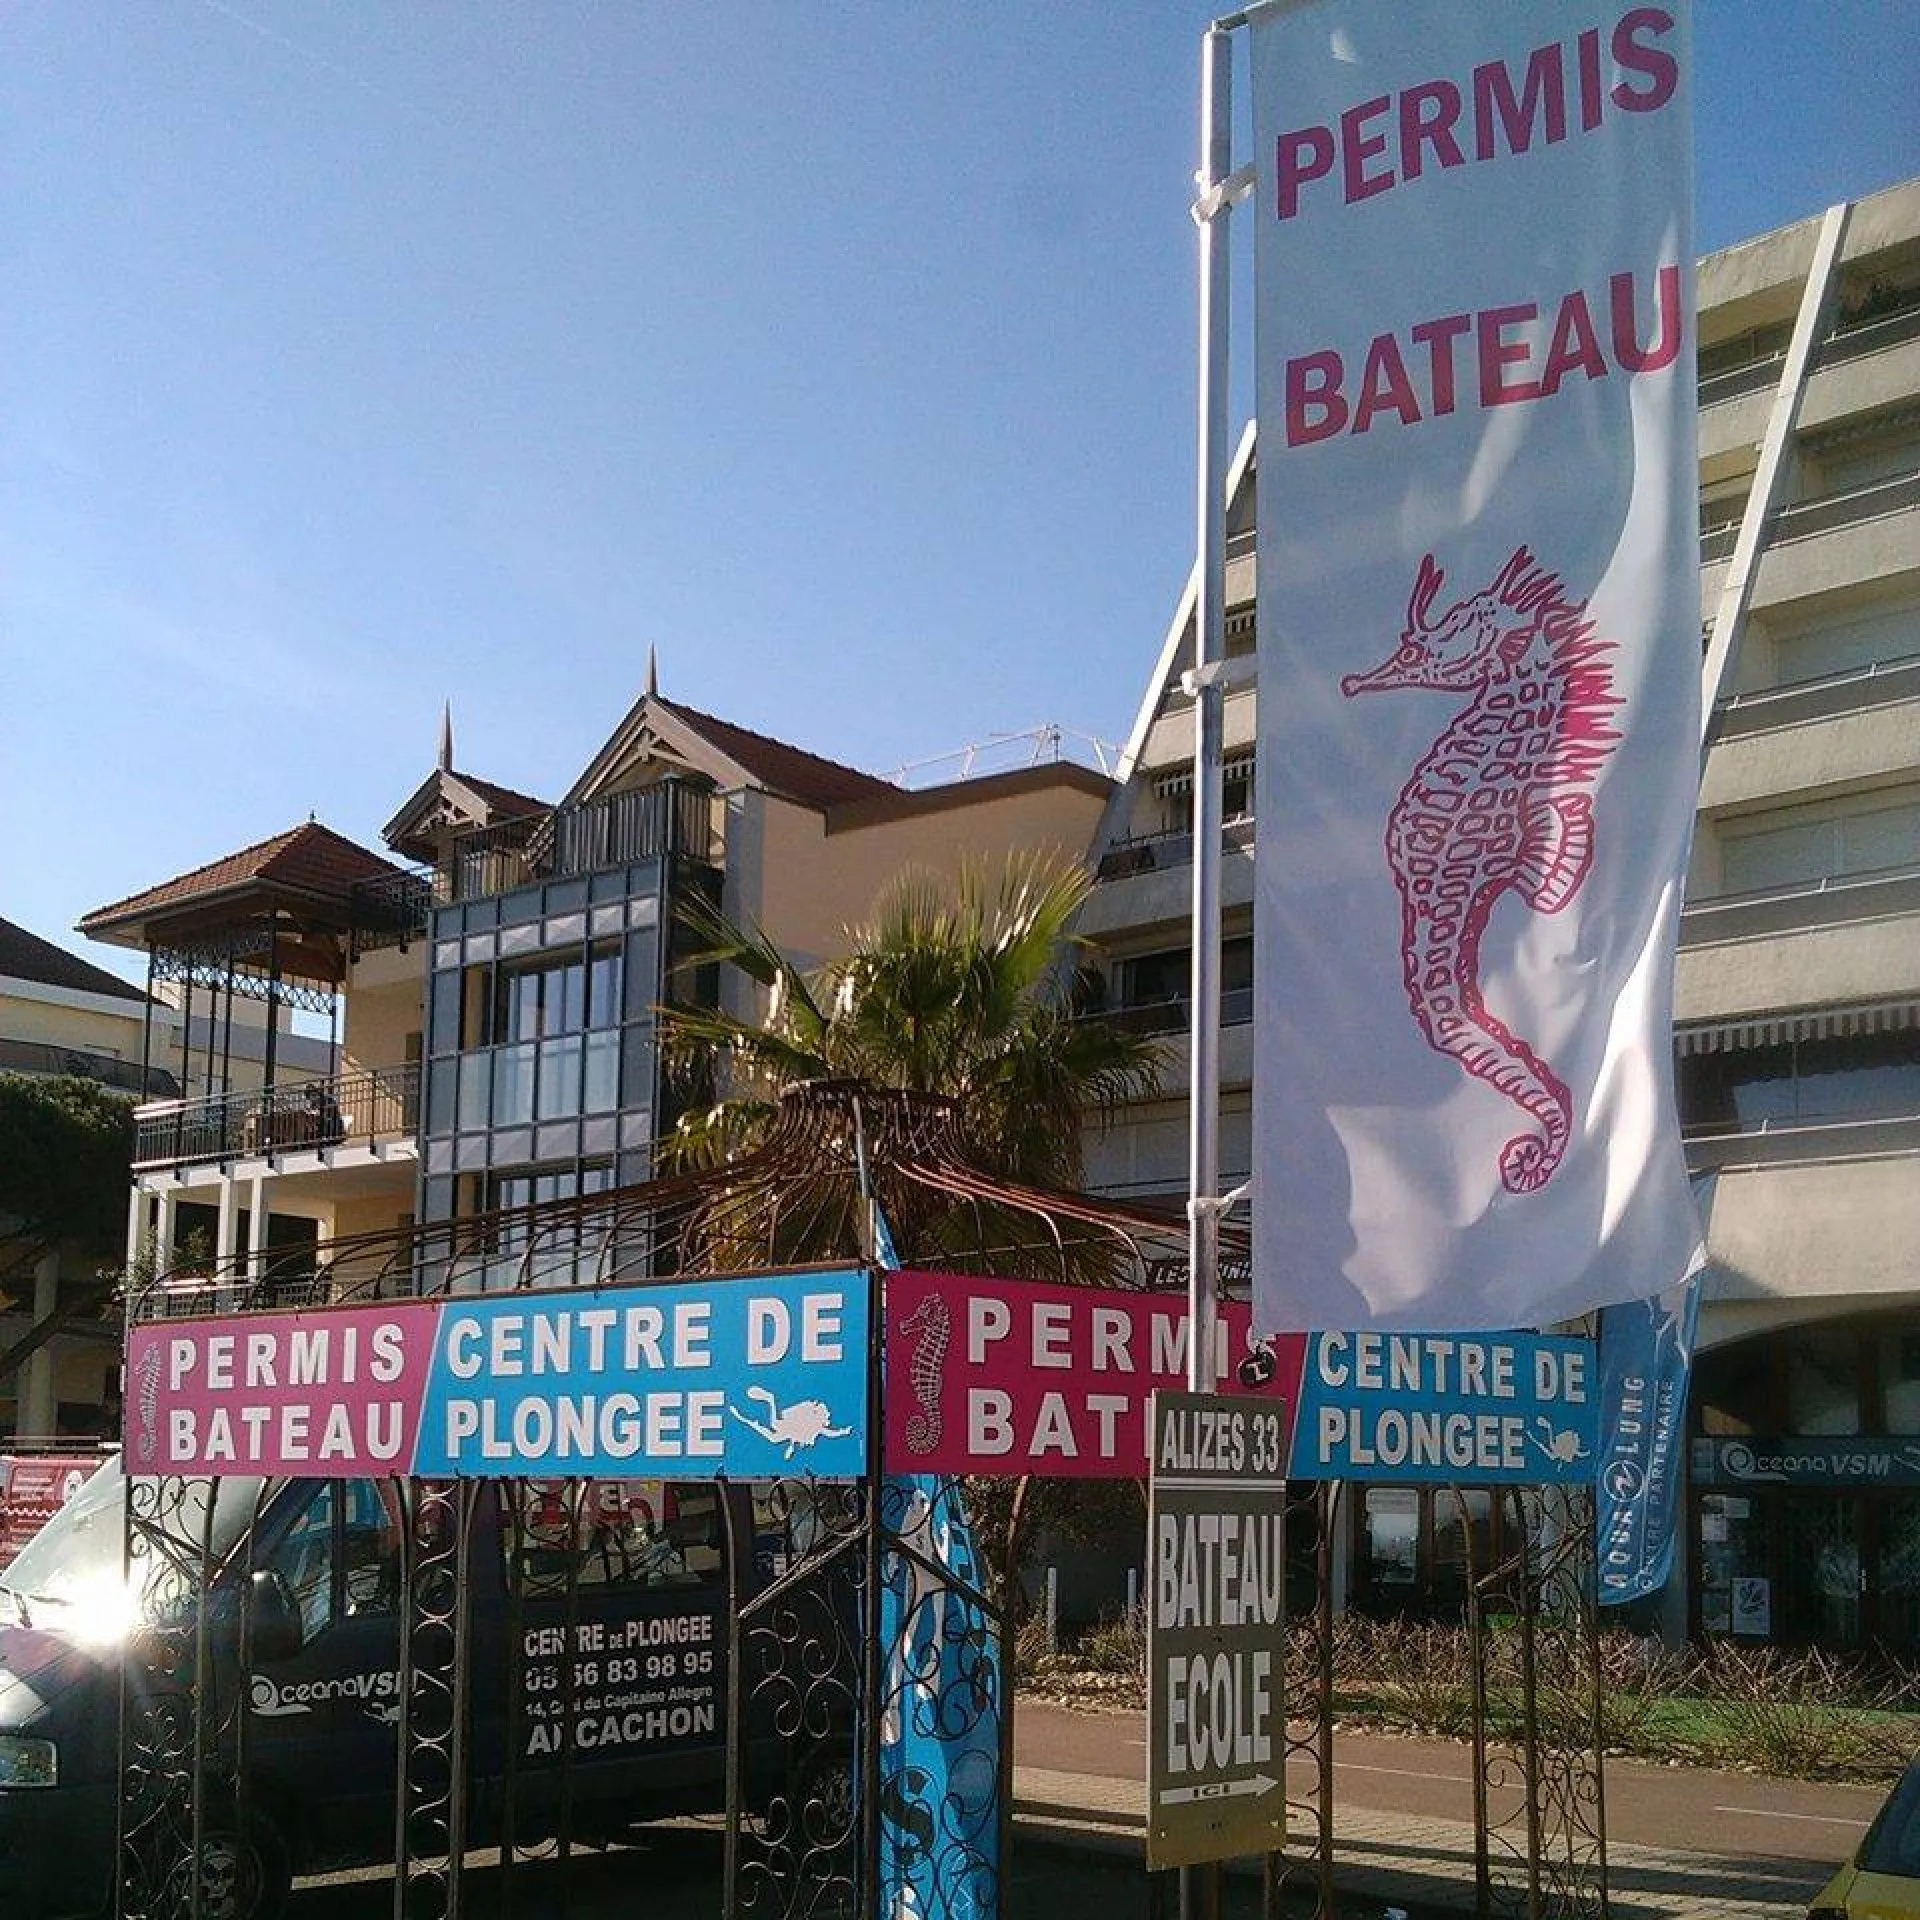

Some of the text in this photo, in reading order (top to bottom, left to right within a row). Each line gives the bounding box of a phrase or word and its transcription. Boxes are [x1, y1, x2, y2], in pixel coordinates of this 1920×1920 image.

[1276, 8, 1679, 220] PERMIS
[1285, 265, 1682, 448] BATEAU
[170, 1324, 404, 1390] PERMIS
[447, 1294, 843, 1378] CENTRE DE
[1318, 1330, 1585, 1402] CENTRE DE
[169, 1402, 403, 1460] BATEAU
[447, 1391, 725, 1458] PLONGEE
[968, 1388, 1152, 1459] BAT
[1162, 1410, 1279, 1472] ALIZES 33
[1319, 1407, 1525, 1469] PLONGEE
[1615, 1377, 1646, 1455] LUNG
[1158, 1515, 1281, 1628] BATEAU
[524, 1624, 604, 1656] CENRE
[626, 1616, 712, 1647] PLONGEE
[607, 1658, 637, 1683] 83
[646, 1653, 676, 1678] 98
[684, 1652, 713, 1675] 95
[1167, 1651, 1271, 1772] ECOLE
[1193, 1782, 1230, 1799] ICI
